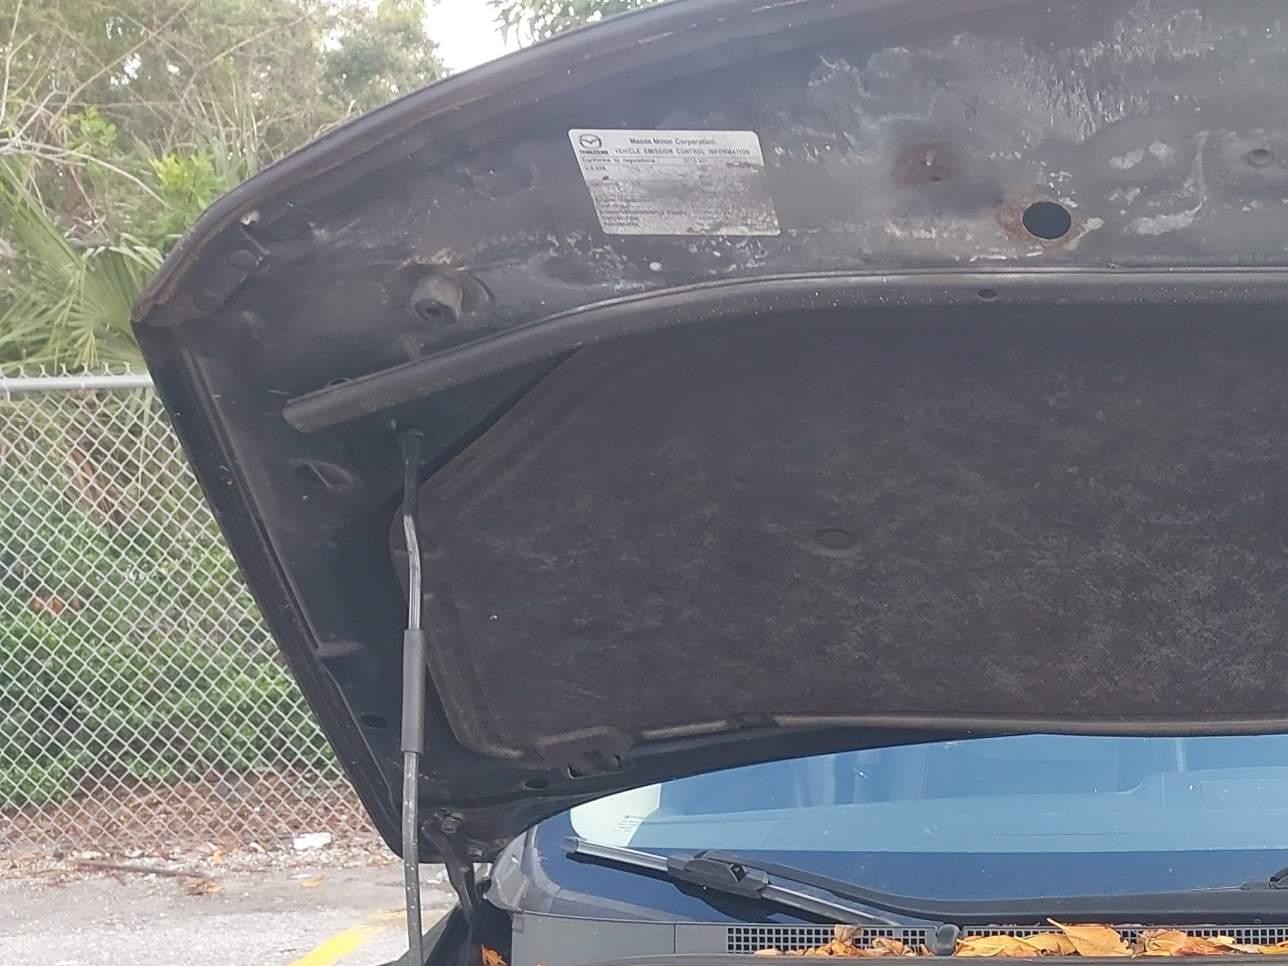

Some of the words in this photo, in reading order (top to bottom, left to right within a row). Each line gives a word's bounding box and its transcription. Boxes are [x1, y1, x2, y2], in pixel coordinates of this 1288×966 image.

[629, 137, 652, 145] Mazda
[653, 137, 673, 145] Motor
[675, 137, 716, 146] Corporation
